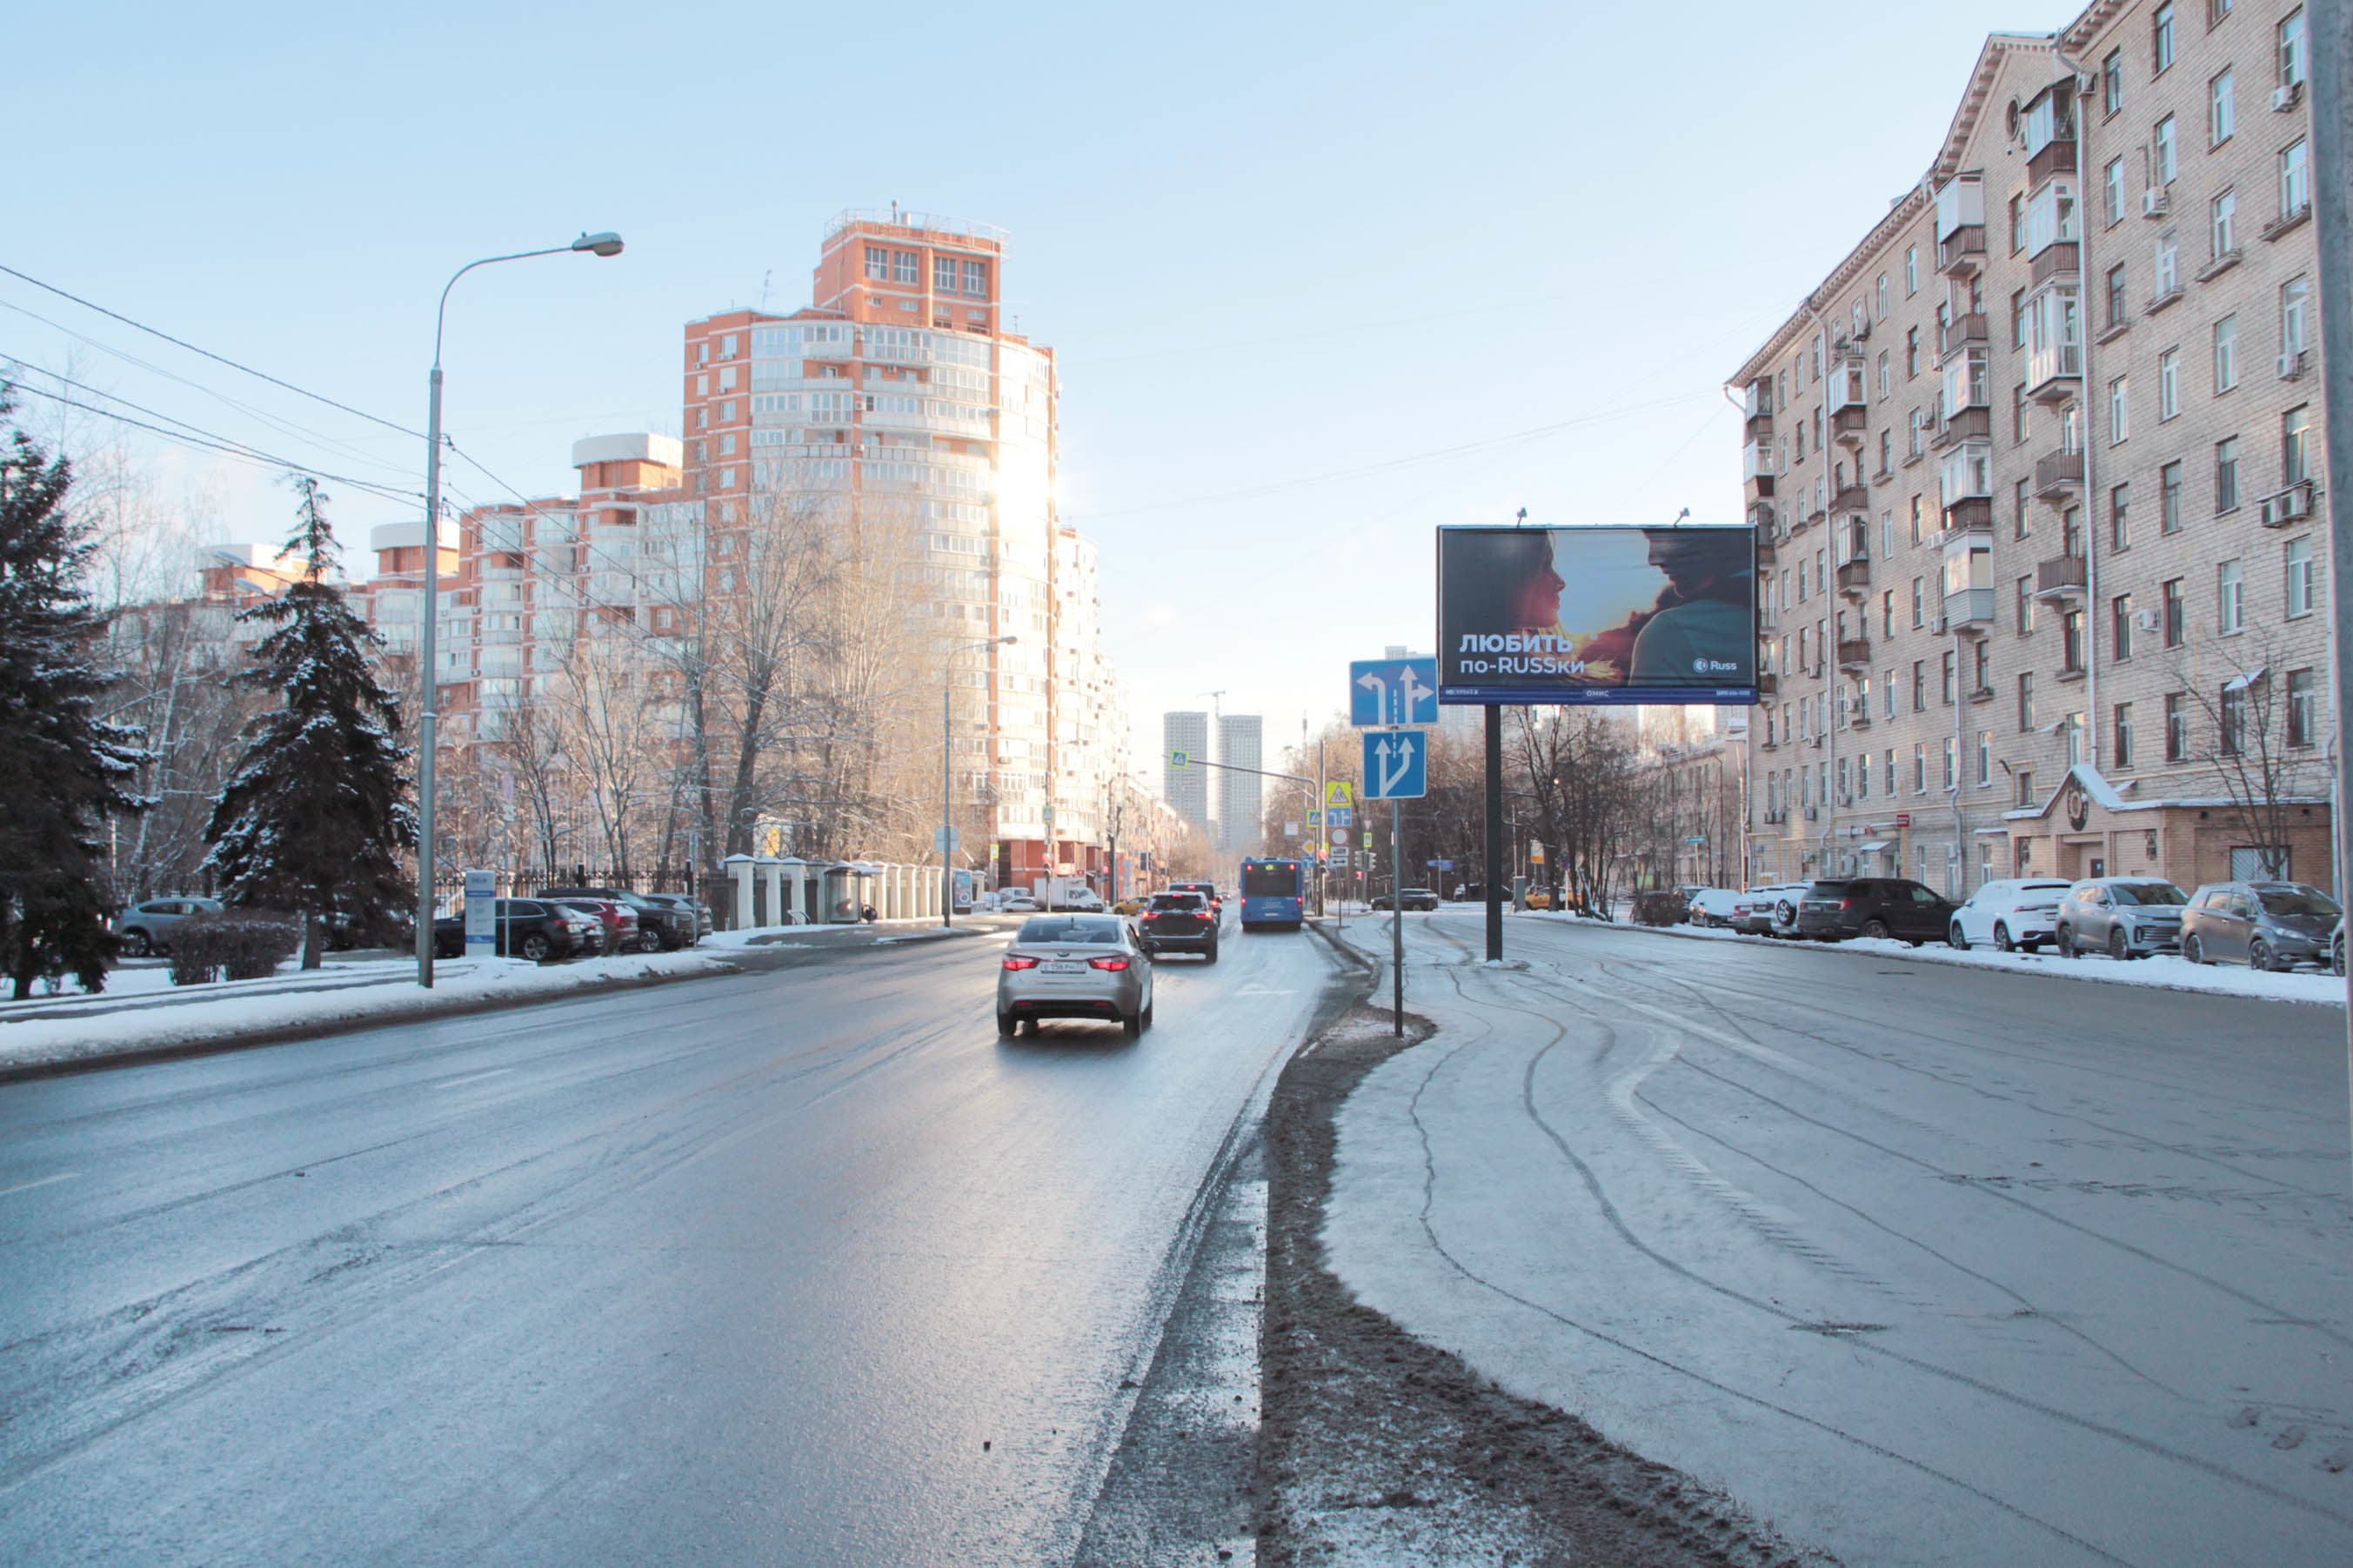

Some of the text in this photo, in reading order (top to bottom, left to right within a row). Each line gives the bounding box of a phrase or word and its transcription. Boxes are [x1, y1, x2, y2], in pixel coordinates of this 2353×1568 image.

[1459, 634, 1574, 653] ЛЮБИТЬ
[1460, 657, 1585, 674] по-RUSSки
[1710, 660, 1738, 671] Russ
